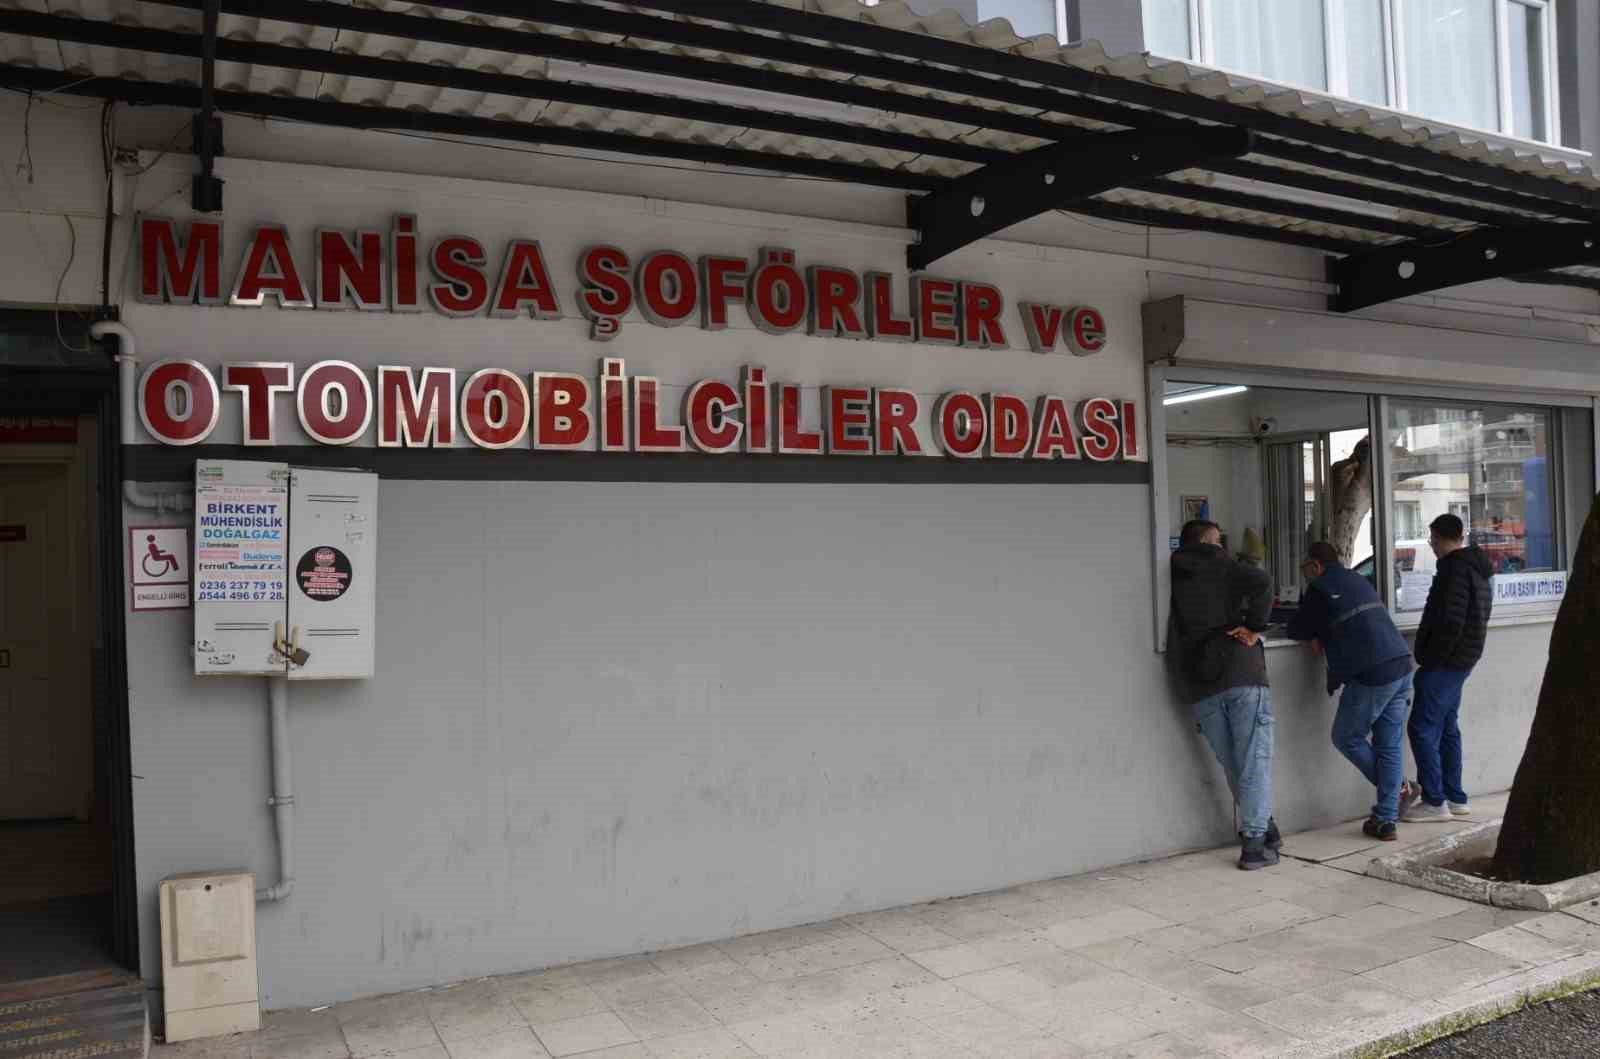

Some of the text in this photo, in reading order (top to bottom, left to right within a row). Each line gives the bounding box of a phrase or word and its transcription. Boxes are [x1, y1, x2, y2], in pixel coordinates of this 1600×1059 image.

[138, 213, 1107, 356] MANİSA ŞOFÖRLER ve
[138, 357, 1149, 462] OTOMOBİLCİLER ODASI
[207, 501, 277, 514] BİRKENT
[200, 515, 283, 527] MÜHENDİSLİK
[203, 528, 280, 539] DOĞALGAZ
[200, 581, 282, 590] 0236 237 79 19
[200, 591, 226, 600] 0544
[229, 591, 249, 600] 496
[253, 591, 266, 600] 67
